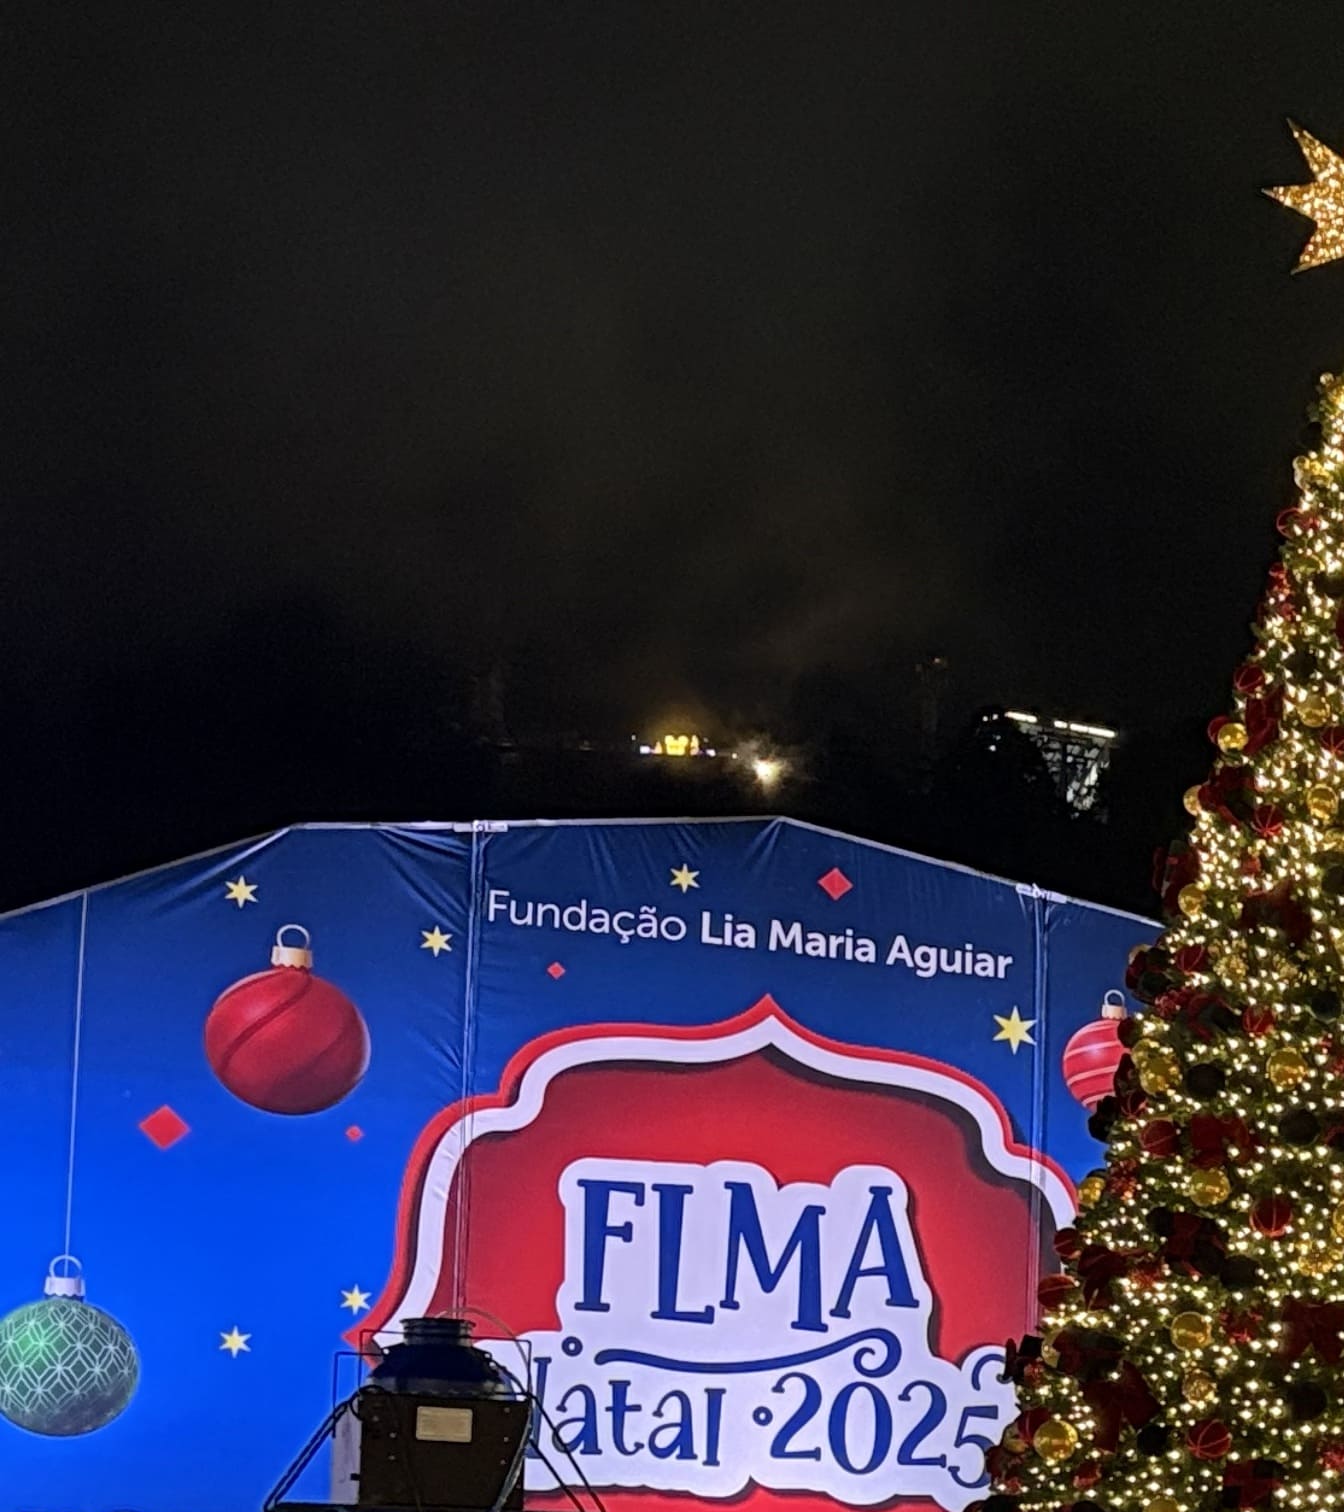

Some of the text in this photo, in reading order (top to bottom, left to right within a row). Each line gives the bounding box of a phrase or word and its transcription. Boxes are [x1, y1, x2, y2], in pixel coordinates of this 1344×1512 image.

[487, 889, 1012, 979] Fundação Lia Maria Aguiar
[574, 1179, 920, 1332] FLMA
[520, 1356, 1000, 1489] atal 2025
